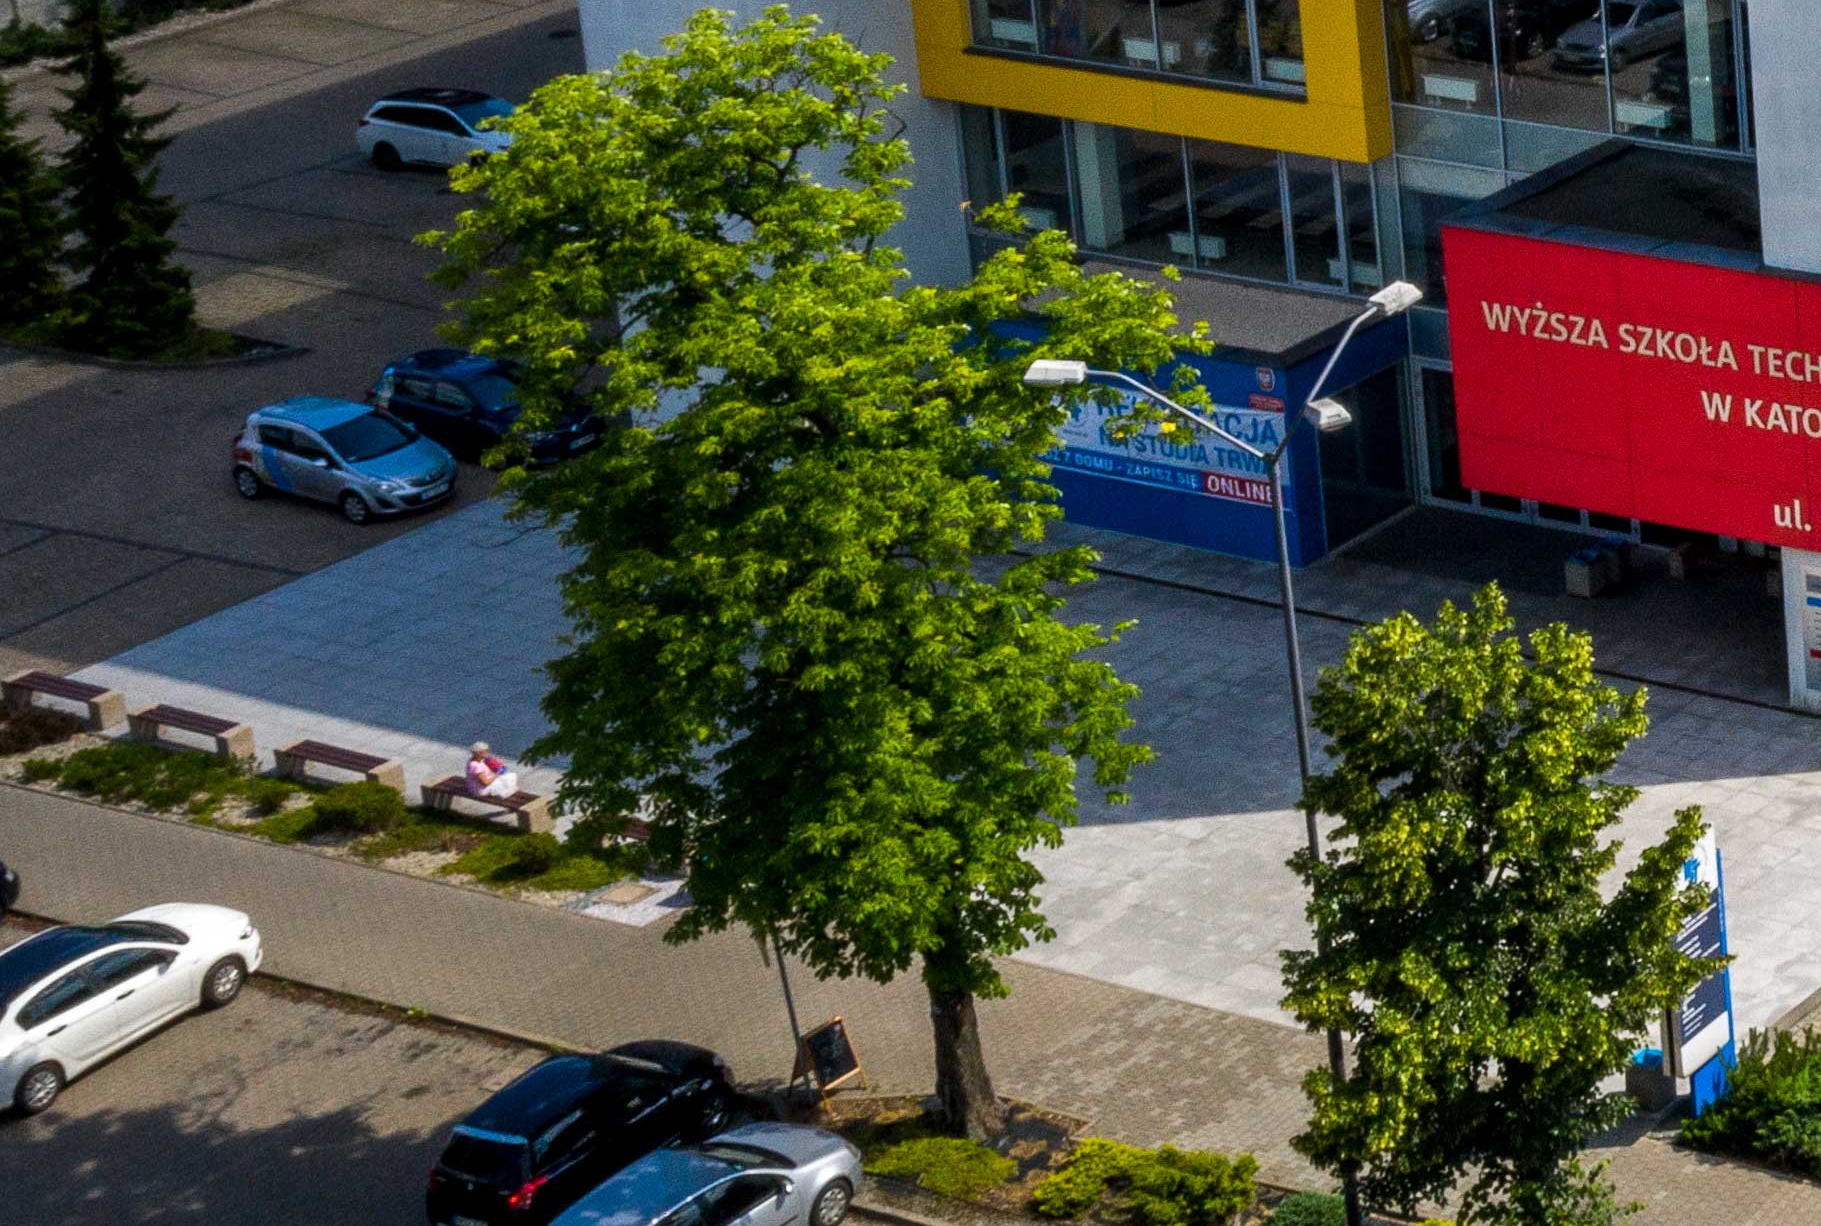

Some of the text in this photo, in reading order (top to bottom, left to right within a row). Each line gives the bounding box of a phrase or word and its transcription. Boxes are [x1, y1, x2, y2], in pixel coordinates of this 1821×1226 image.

[1481, 301, 1609, 349] WYŻSZA
[1617, 323, 1738, 371] SZKOŁA
[1700, 390, 1732, 423] W
[1773, 500, 1812, 532] ul.
